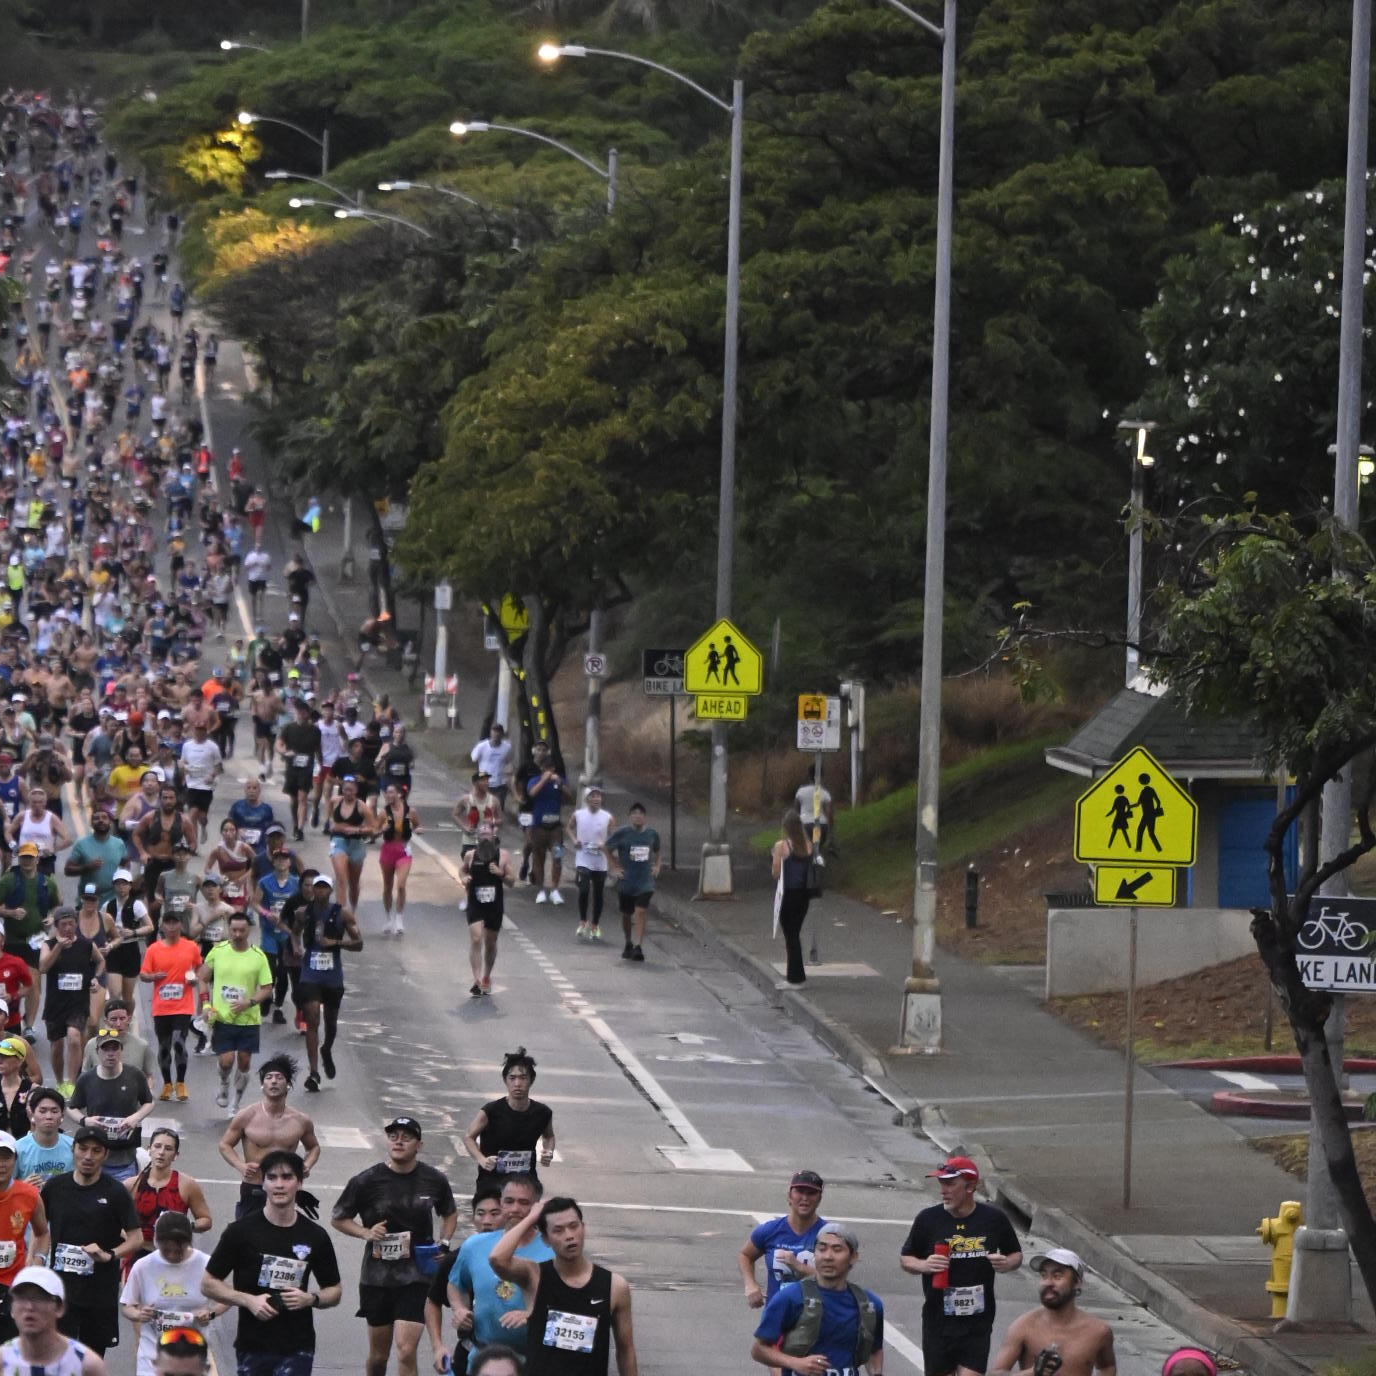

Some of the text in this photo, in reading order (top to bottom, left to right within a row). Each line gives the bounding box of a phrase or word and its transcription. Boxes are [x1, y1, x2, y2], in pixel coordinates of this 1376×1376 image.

[701, 701, 741, 714] AHEAD
[1300, 960, 1376, 984] KE LAN
[61, 1256, 87, 1267] 32299
[553, 1326, 585, 1340] 32155
